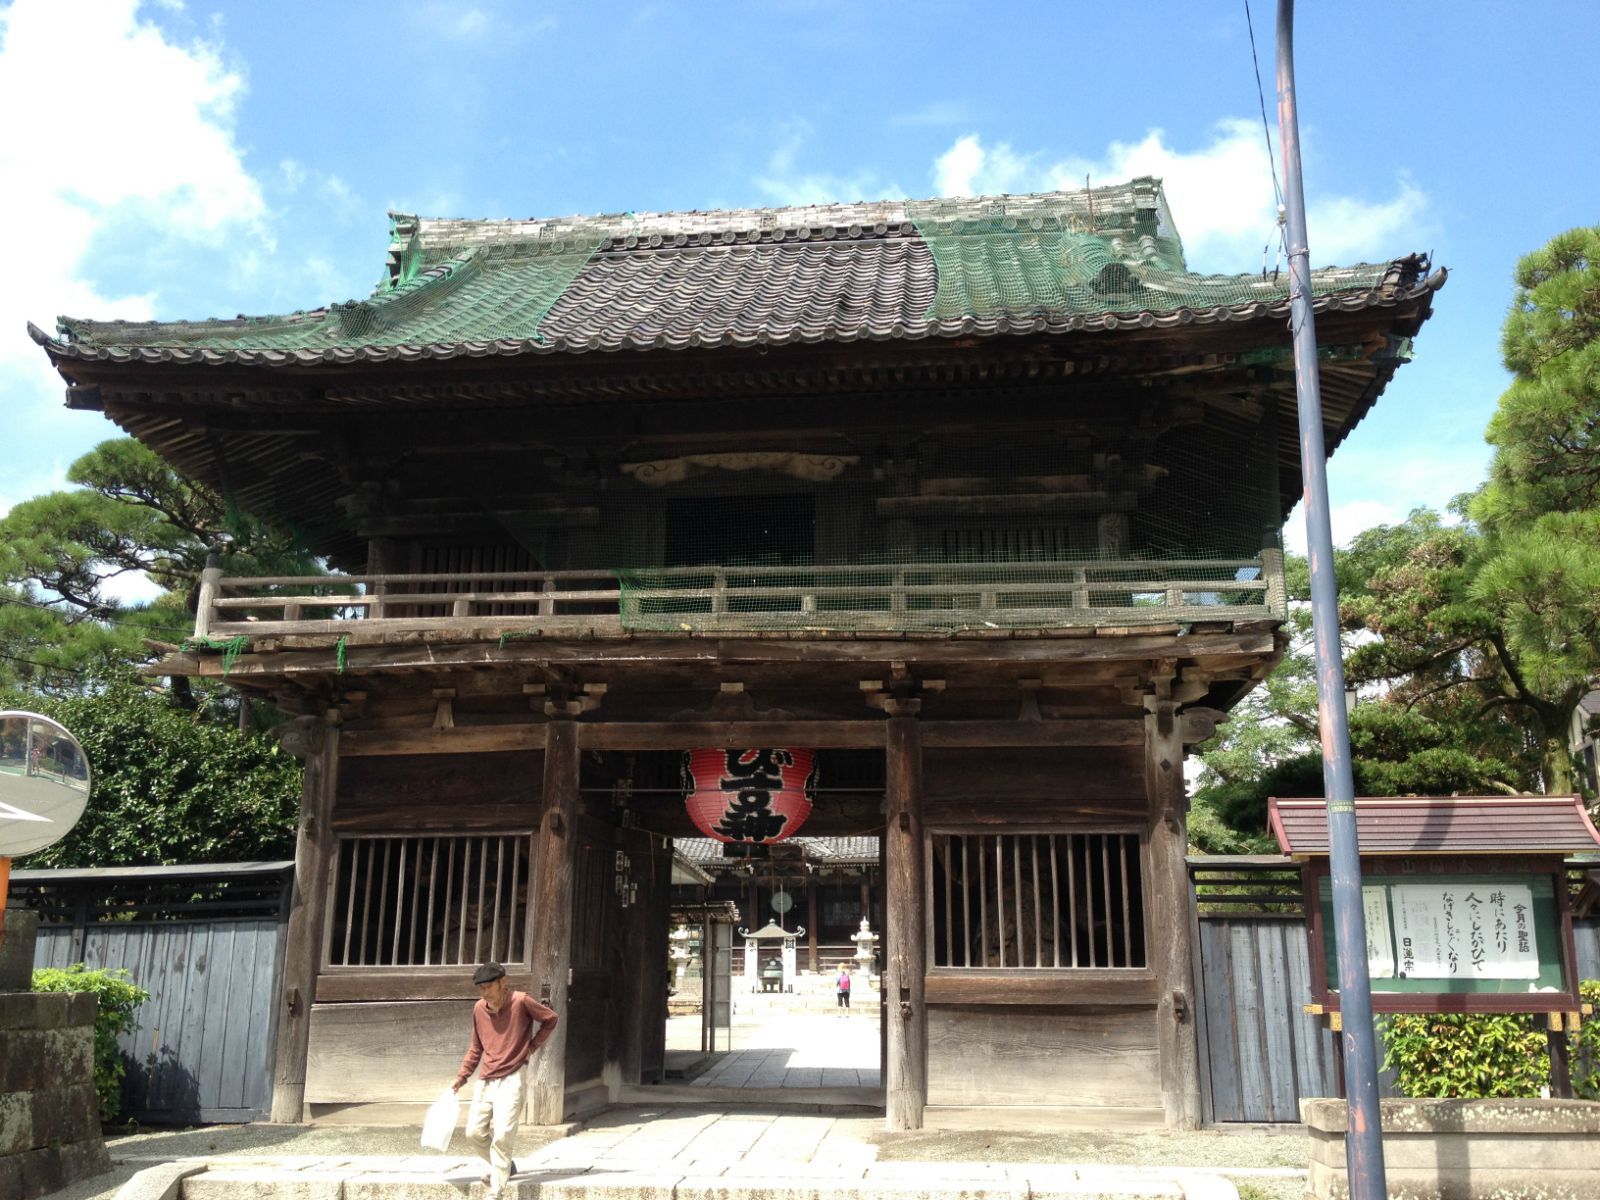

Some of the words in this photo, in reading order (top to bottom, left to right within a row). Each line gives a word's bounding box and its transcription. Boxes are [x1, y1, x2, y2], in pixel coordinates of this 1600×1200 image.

[1489, 890, 1508, 953] 時にあたり
[1403, 937, 1415, 973] 日蓮宗
